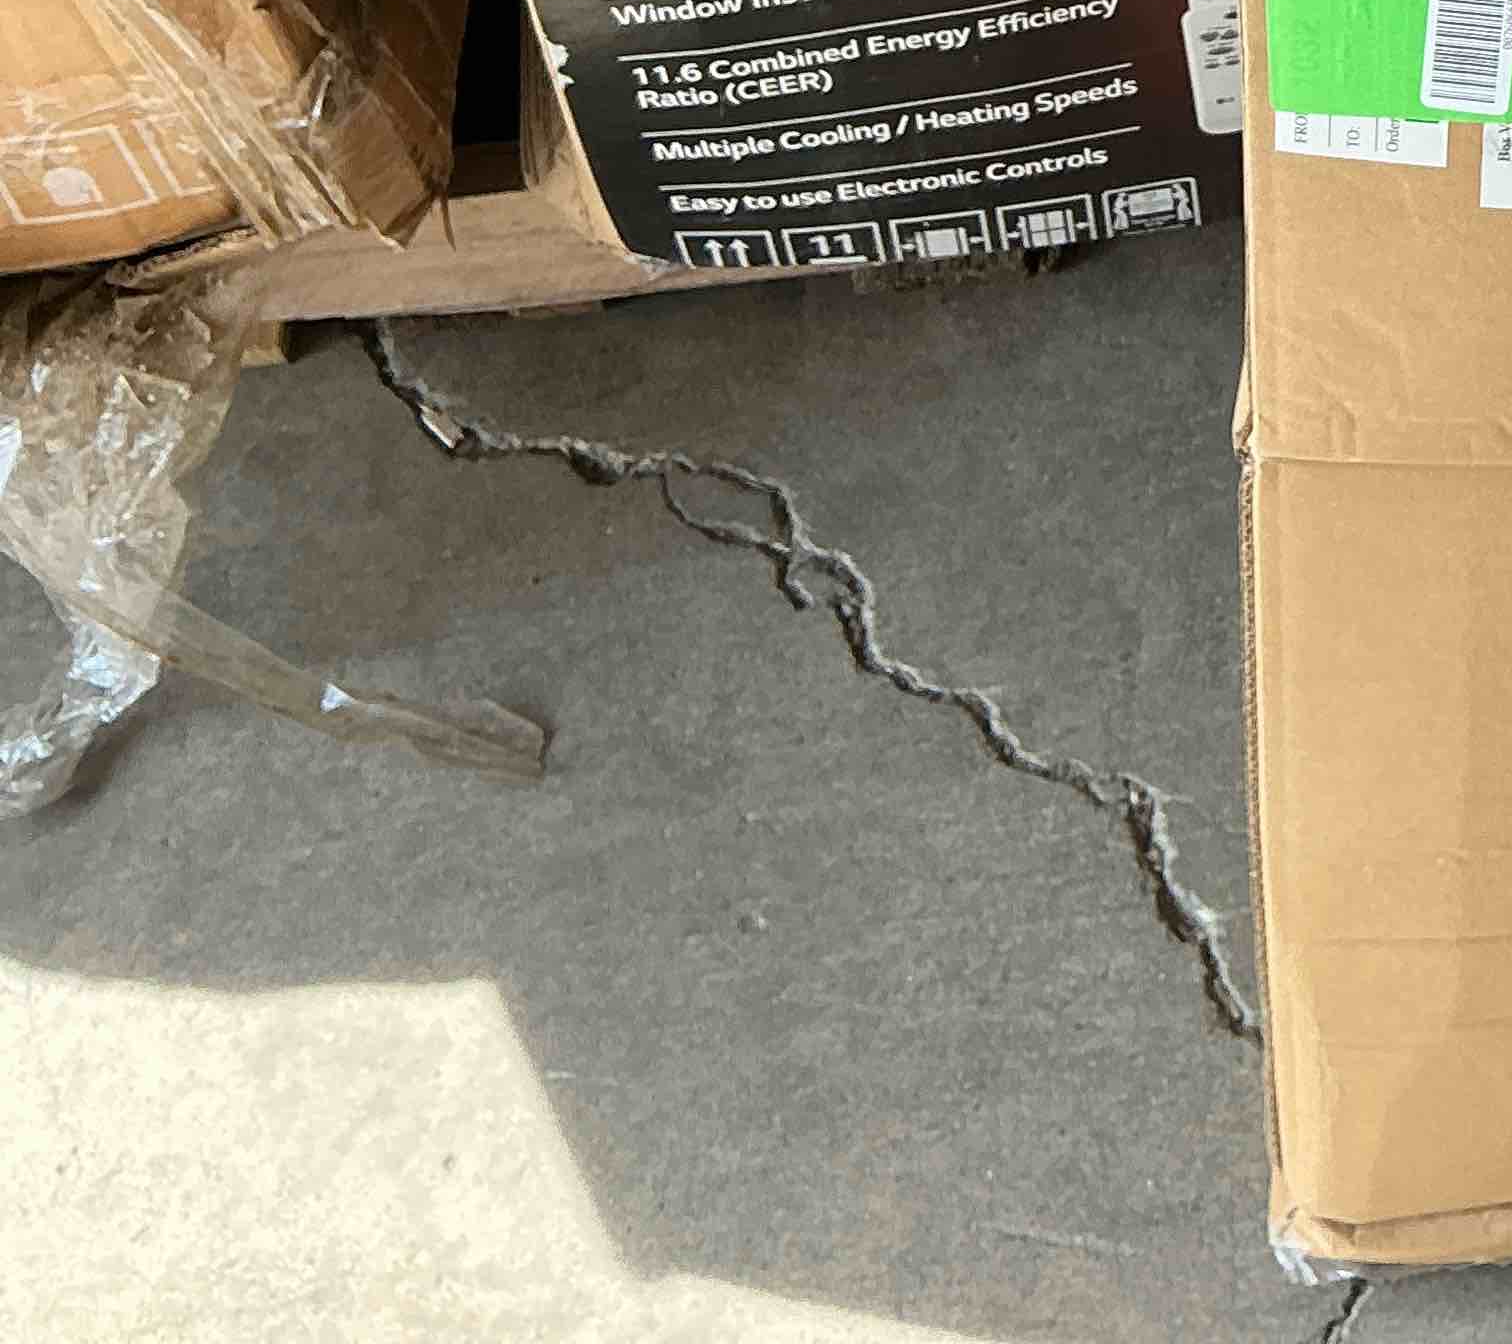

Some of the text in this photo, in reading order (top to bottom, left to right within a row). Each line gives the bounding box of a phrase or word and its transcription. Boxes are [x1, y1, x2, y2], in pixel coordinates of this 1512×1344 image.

[633, 61, 702, 87] 11.6
[709, 37, 860, 81] Combined
[867, 23, 971, 63] Energy
[637, 67, 834, 111] Ratio (CEER)
[653, 134, 775, 165] Multiple
[780, 117, 891, 153] Cooling
[915, 97, 1031, 136] Heating
[1035, 74, 1139, 118] Speeds
[1294, 112, 1309, 143] FRO
[1346, 126, 1361, 147] TO:
[1387, 118, 1401, 152] Order
[670, 145, 1109, 218] Easy to use Electronic Controls
